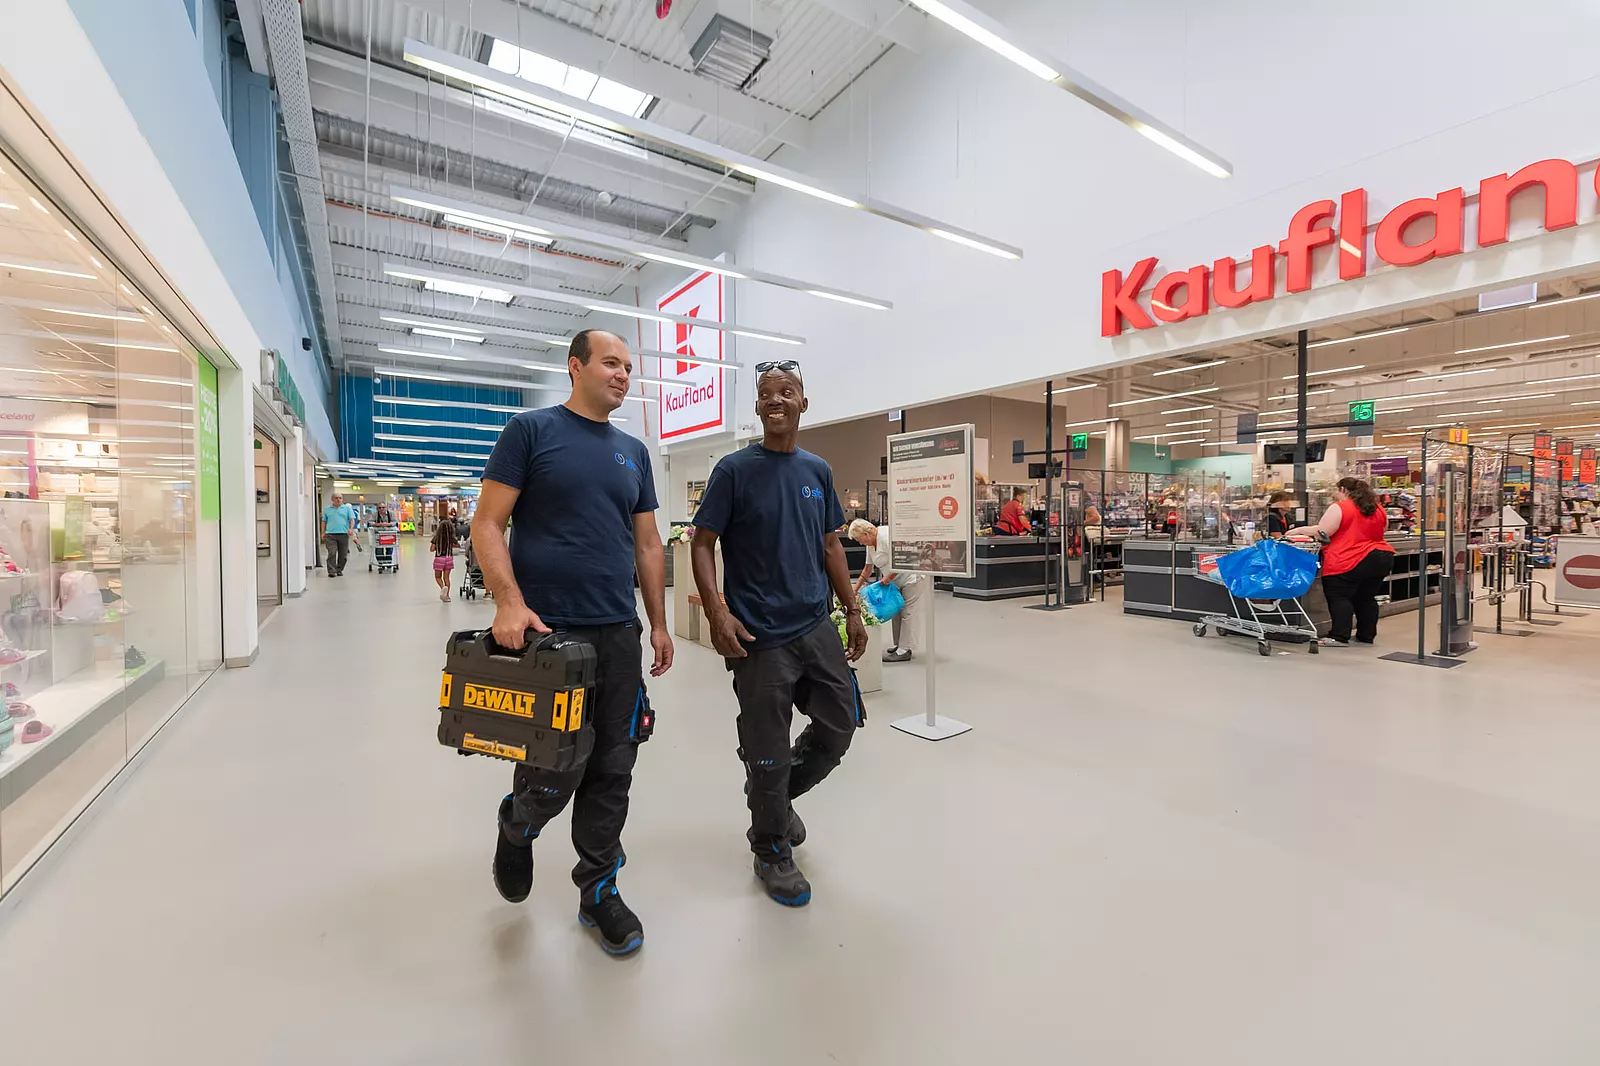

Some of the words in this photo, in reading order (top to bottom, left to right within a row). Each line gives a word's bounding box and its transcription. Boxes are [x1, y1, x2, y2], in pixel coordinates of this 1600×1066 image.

[1101, 158, 1600, 338] Kauflan
[665, 376, 714, 413] Kaufland
[1351, 404, 1371, 421] 15
[1073, 436, 1085, 449] 17
